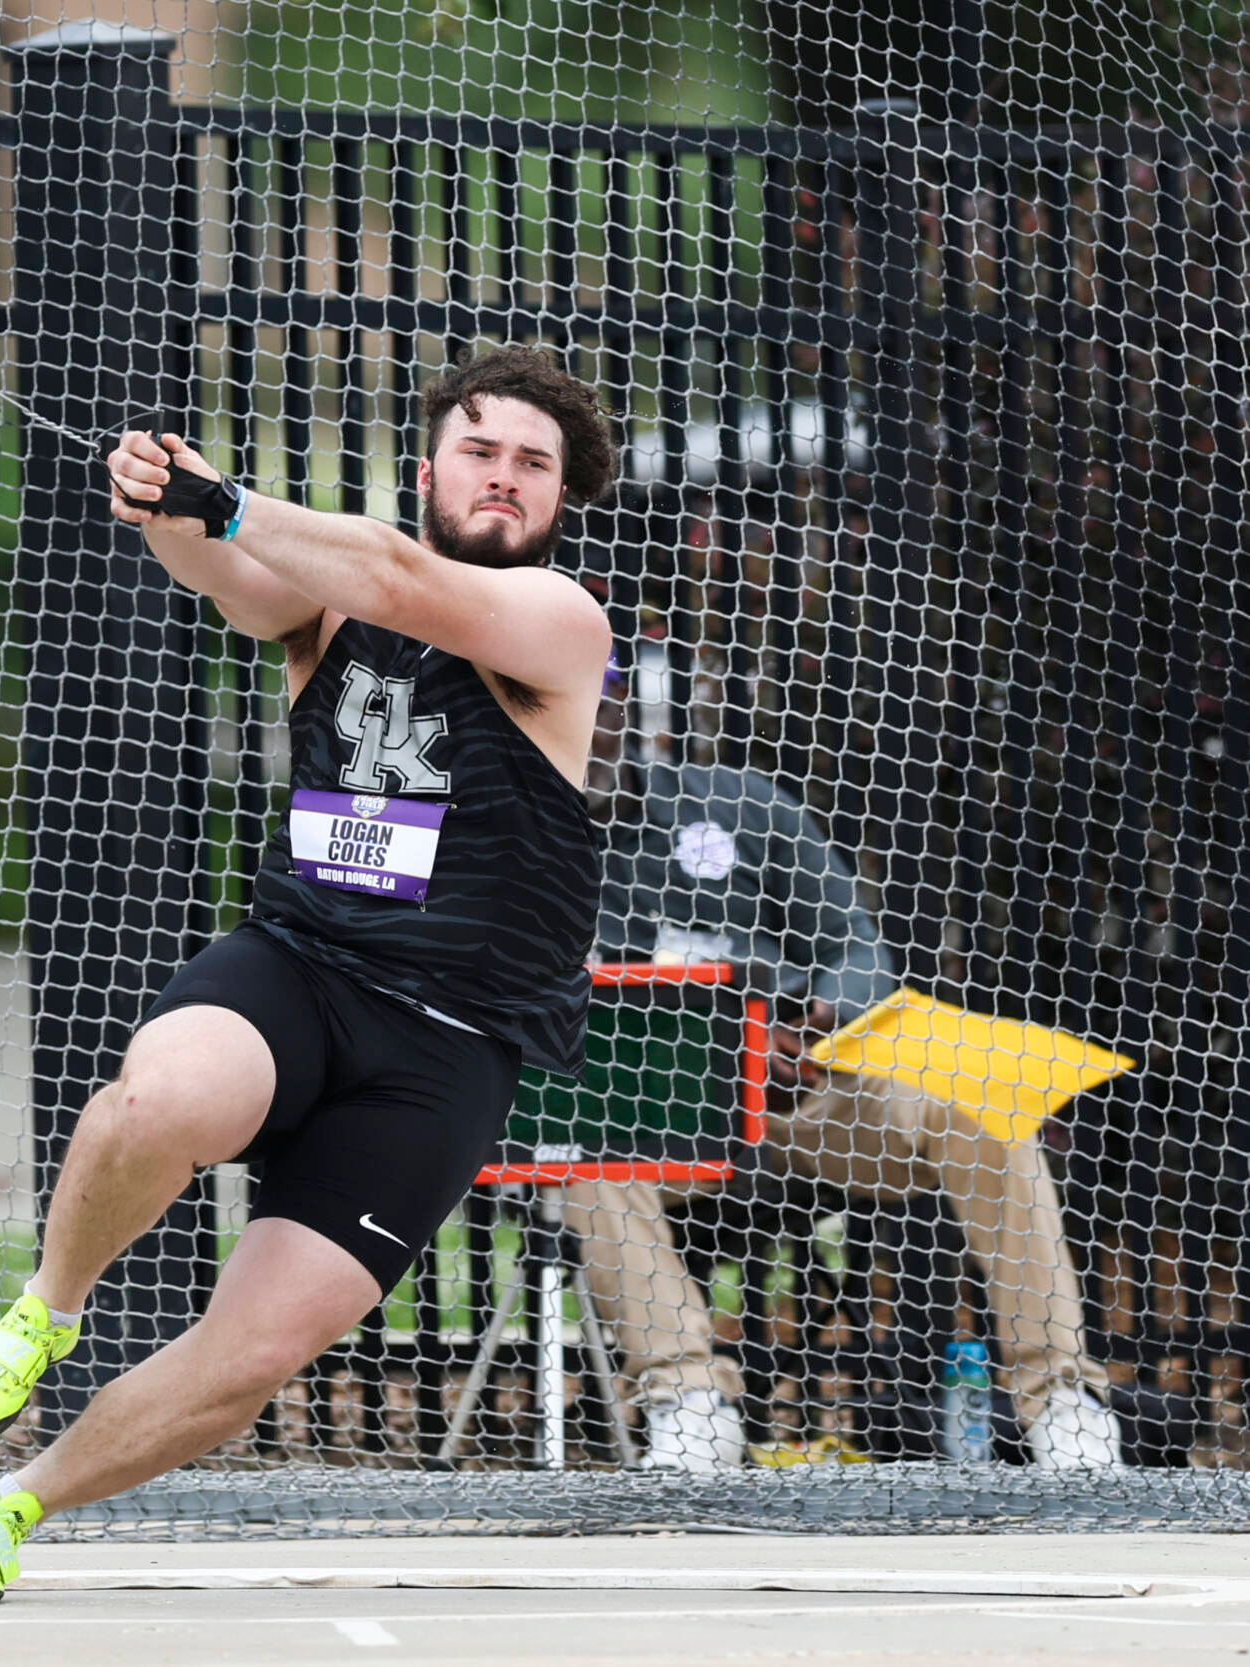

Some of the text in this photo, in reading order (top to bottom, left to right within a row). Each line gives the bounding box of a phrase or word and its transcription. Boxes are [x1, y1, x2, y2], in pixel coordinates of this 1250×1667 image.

[334, 660, 451, 793] UK
[329, 818, 394, 846] LOGAN
[328, 840, 388, 868] COLES
[316, 867, 396, 891] BATON ROUGE, LA
